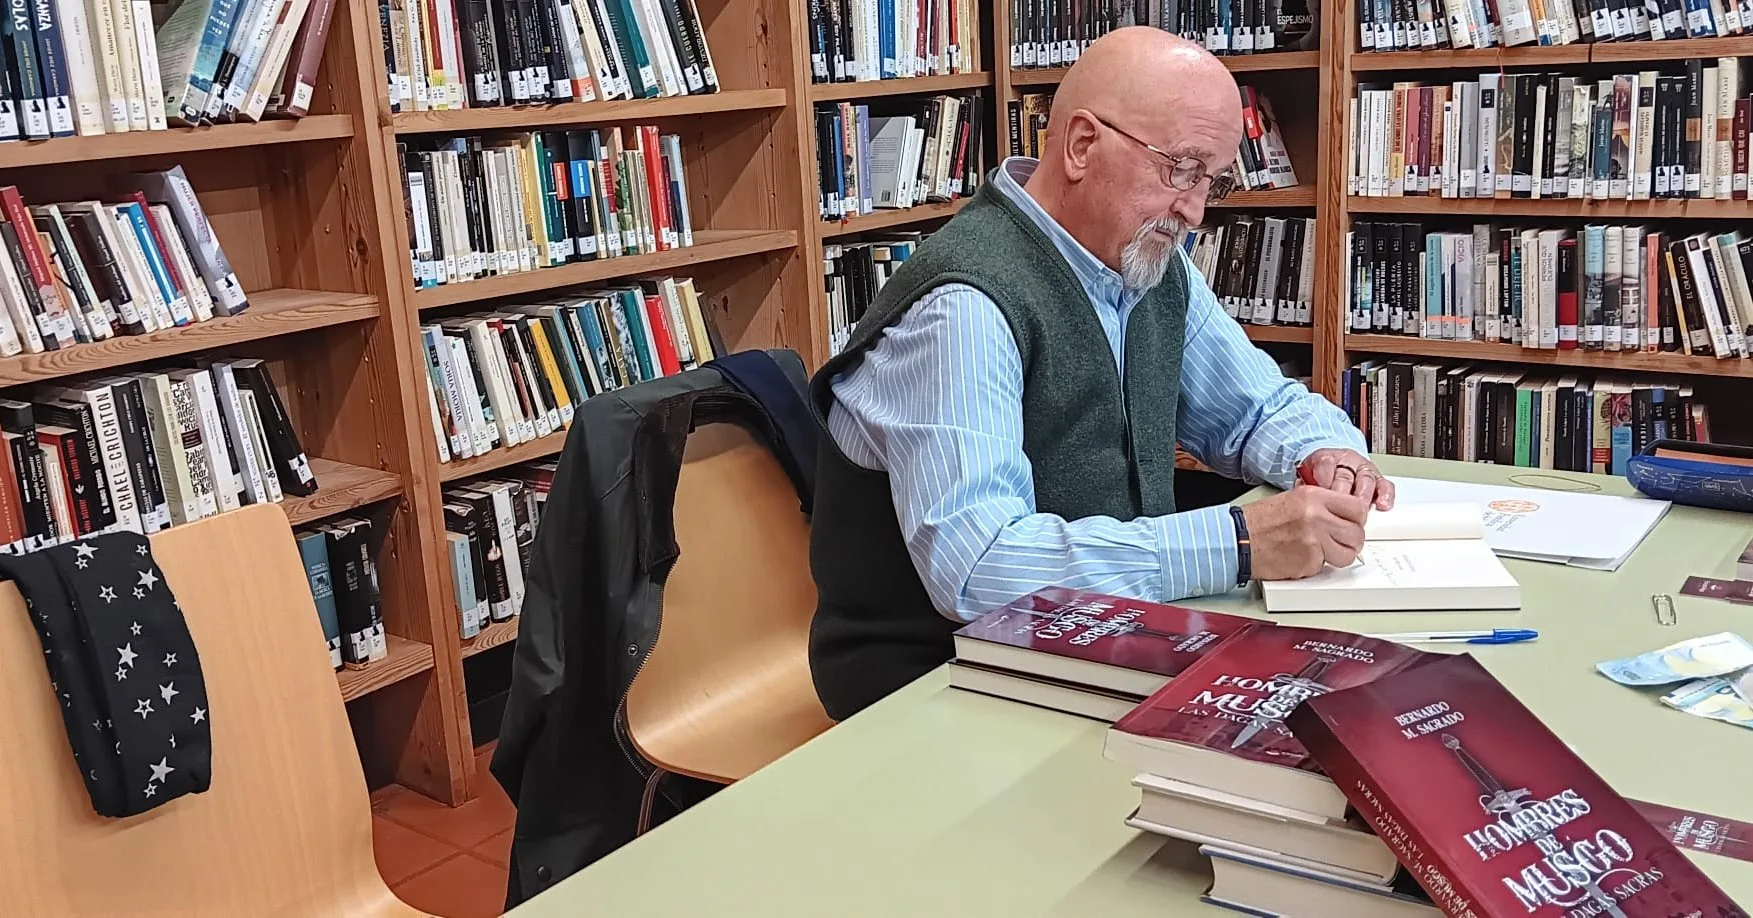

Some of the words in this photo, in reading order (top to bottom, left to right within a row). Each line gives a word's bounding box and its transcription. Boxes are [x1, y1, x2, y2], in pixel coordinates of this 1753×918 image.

[1276, 15, 1314, 25] ESPEJISMO
[1457, 239, 1465, 263] VICIO
[1680, 255, 1692, 286] ORÁCULO
[442, 360, 456, 389] SORIA
[449, 389, 464, 422] MORIA
[1392, 375, 1400, 409] Llamazares
[81, 410, 94, 439] CRICHTON
[96, 392, 122, 461] CRICHTON
[87, 439, 99, 464] MICHAEL
[113, 469, 133, 511] CHAEL
[1036, 601, 1115, 640] MUSGO
[1304, 640, 1374, 658] BERNARDO
[1308, 646, 1375, 664] SAGRADO
[1210, 675, 1321, 702] HOMBR
[1178, 706, 1210, 716] LAS
[1218, 712, 1269, 729] DAGAS
[1188, 690, 1293, 720] MUS
[1394, 701, 1450, 726] BERNARDO
[1401, 728, 1419, 740] M.
[1416, 712, 1465, 734] SAGRADO
[1356, 780, 1384, 812] SACRAS
[1375, 816, 1414, 860] SAGRADO
[1384, 812, 1408, 841] DAGAS
[1463, 788, 1591, 861] HOMBRES
[1408, 840, 1424, 859] LAS
[1534, 834, 1563, 857] DE
[1426, 864, 1456, 898] MUSGO
[1502, 829, 1634, 913] MUSGO
[1570, 892, 1617, 918] DAGAS
[1614, 866, 1664, 900] SACRAS
